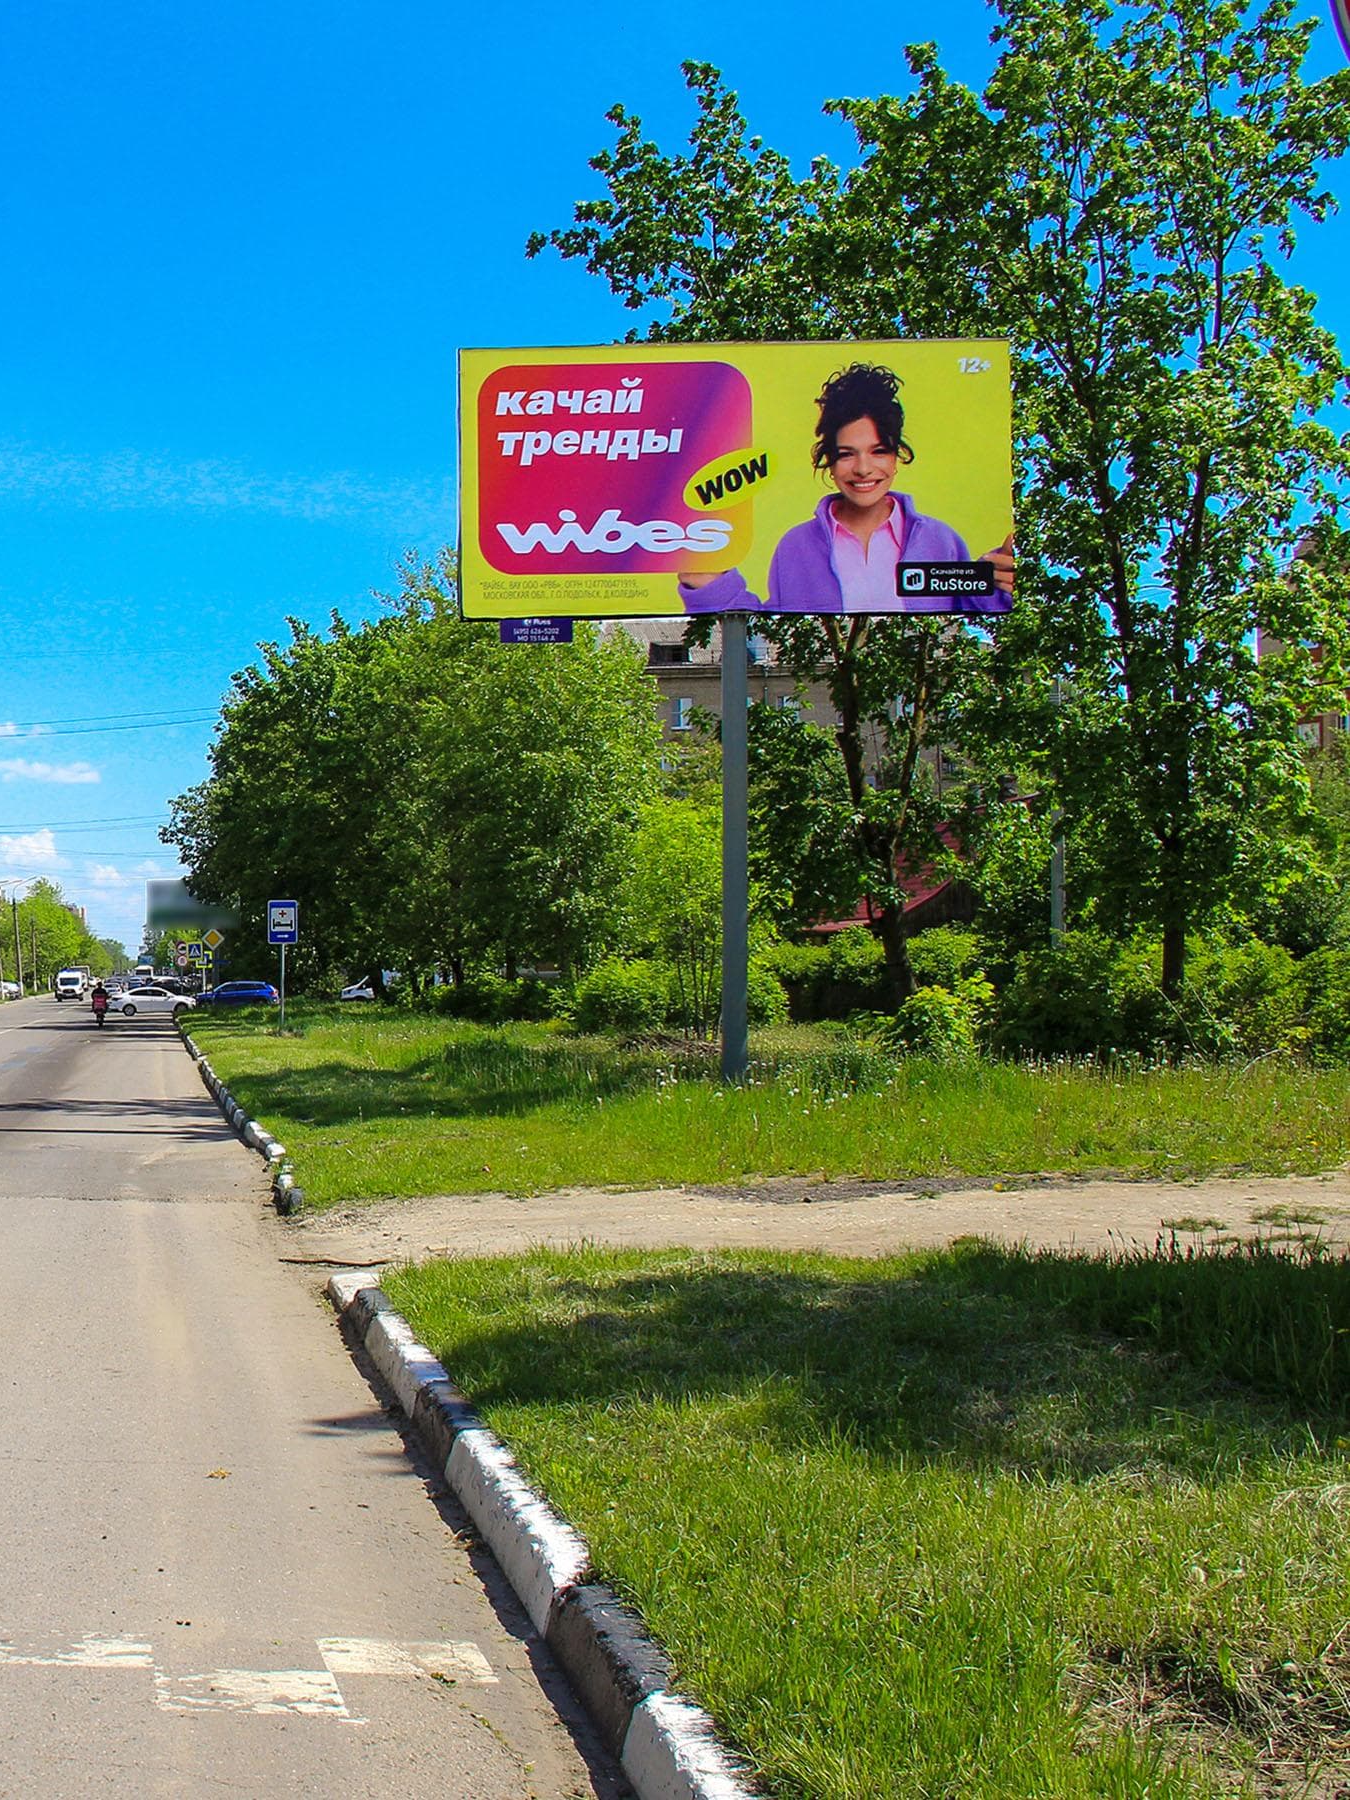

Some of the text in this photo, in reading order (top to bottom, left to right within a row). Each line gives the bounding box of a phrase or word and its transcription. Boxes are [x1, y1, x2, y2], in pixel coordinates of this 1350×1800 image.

[957, 357, 991, 373] 12+
[495, 377, 644, 416] качай
[497, 428, 684, 466] тренды
[694, 453, 769, 506] WOW
[930, 578, 988, 591] RuStore
